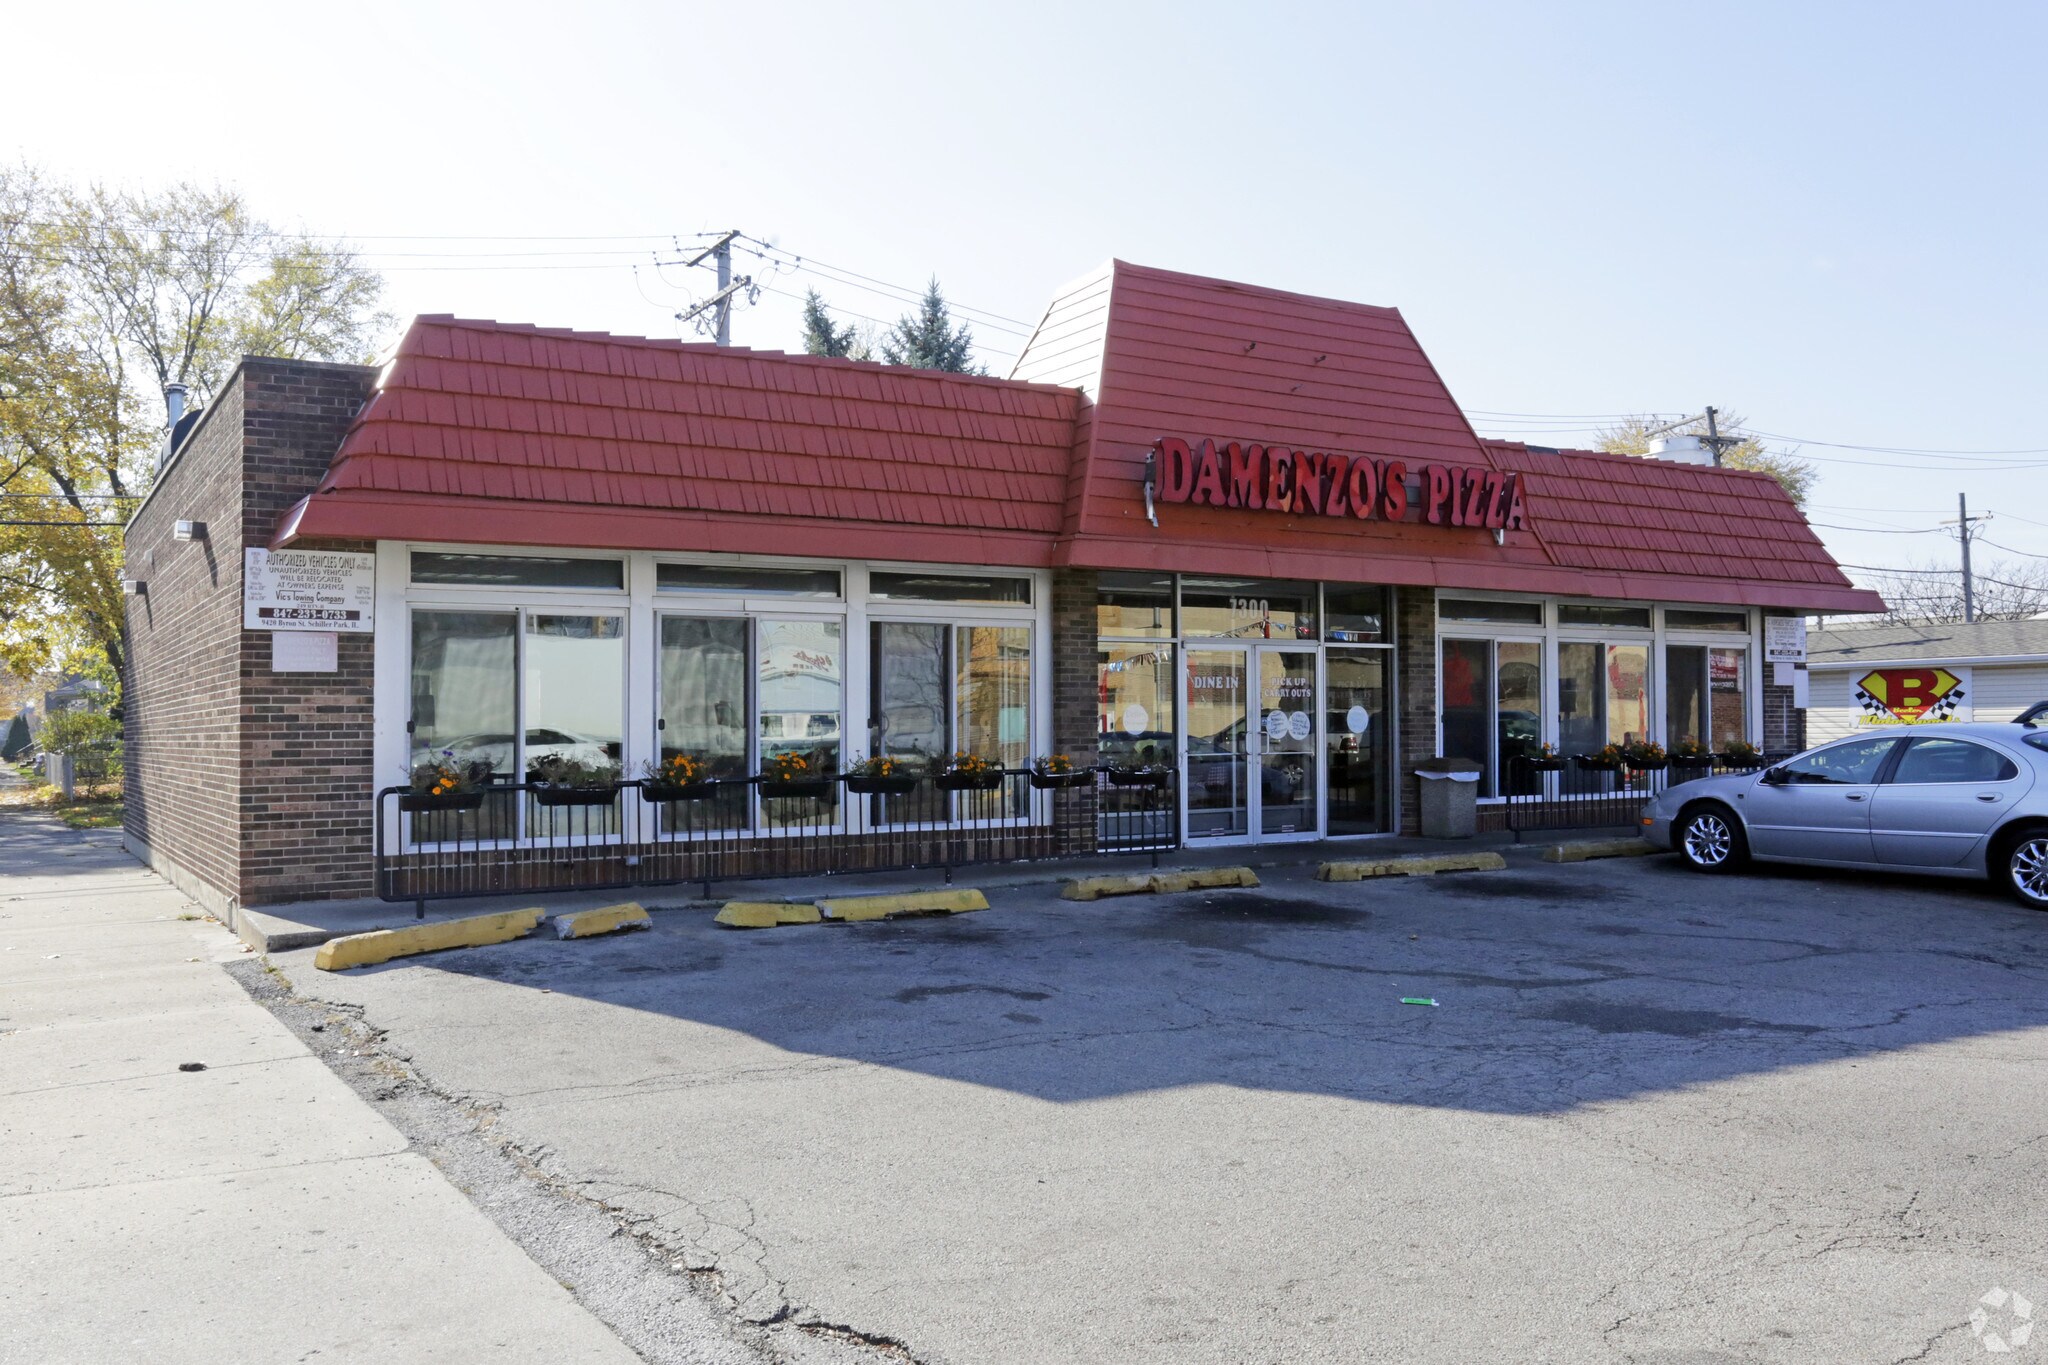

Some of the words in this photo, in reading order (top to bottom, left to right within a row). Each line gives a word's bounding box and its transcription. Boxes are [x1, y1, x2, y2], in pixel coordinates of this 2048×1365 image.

[1155, 437, 1407, 521] DAMENZO'S
[1422, 465, 1529, 530] PIZZA
[266, 553, 307, 567] AUTHORIZED
[308, 555, 337, 568] VEHICLES
[339, 556, 356, 570] ONLY
[269, 567, 321, 575] UNAUTHORIZED
[322, 569, 352, 577] VEHICLES
[293, 590, 314, 604] Towing
[316, 591, 346, 604] Company
[272, 608, 348, 620] 847-233-0733
[1229, 598, 1270, 620] 7300
[278, 620, 297, 628] Byron
[1194, 677, 1224, 689] DINE
[1225, 677, 1239, 688] IN
[1271, 677, 1292, 686] PICK
[1294, 677, 1306, 686] UP
[1264, 688, 1290, 698] CARRY
[1291, 688, 1311, 698] OUTS
[1886, 669, 1939, 708] B
